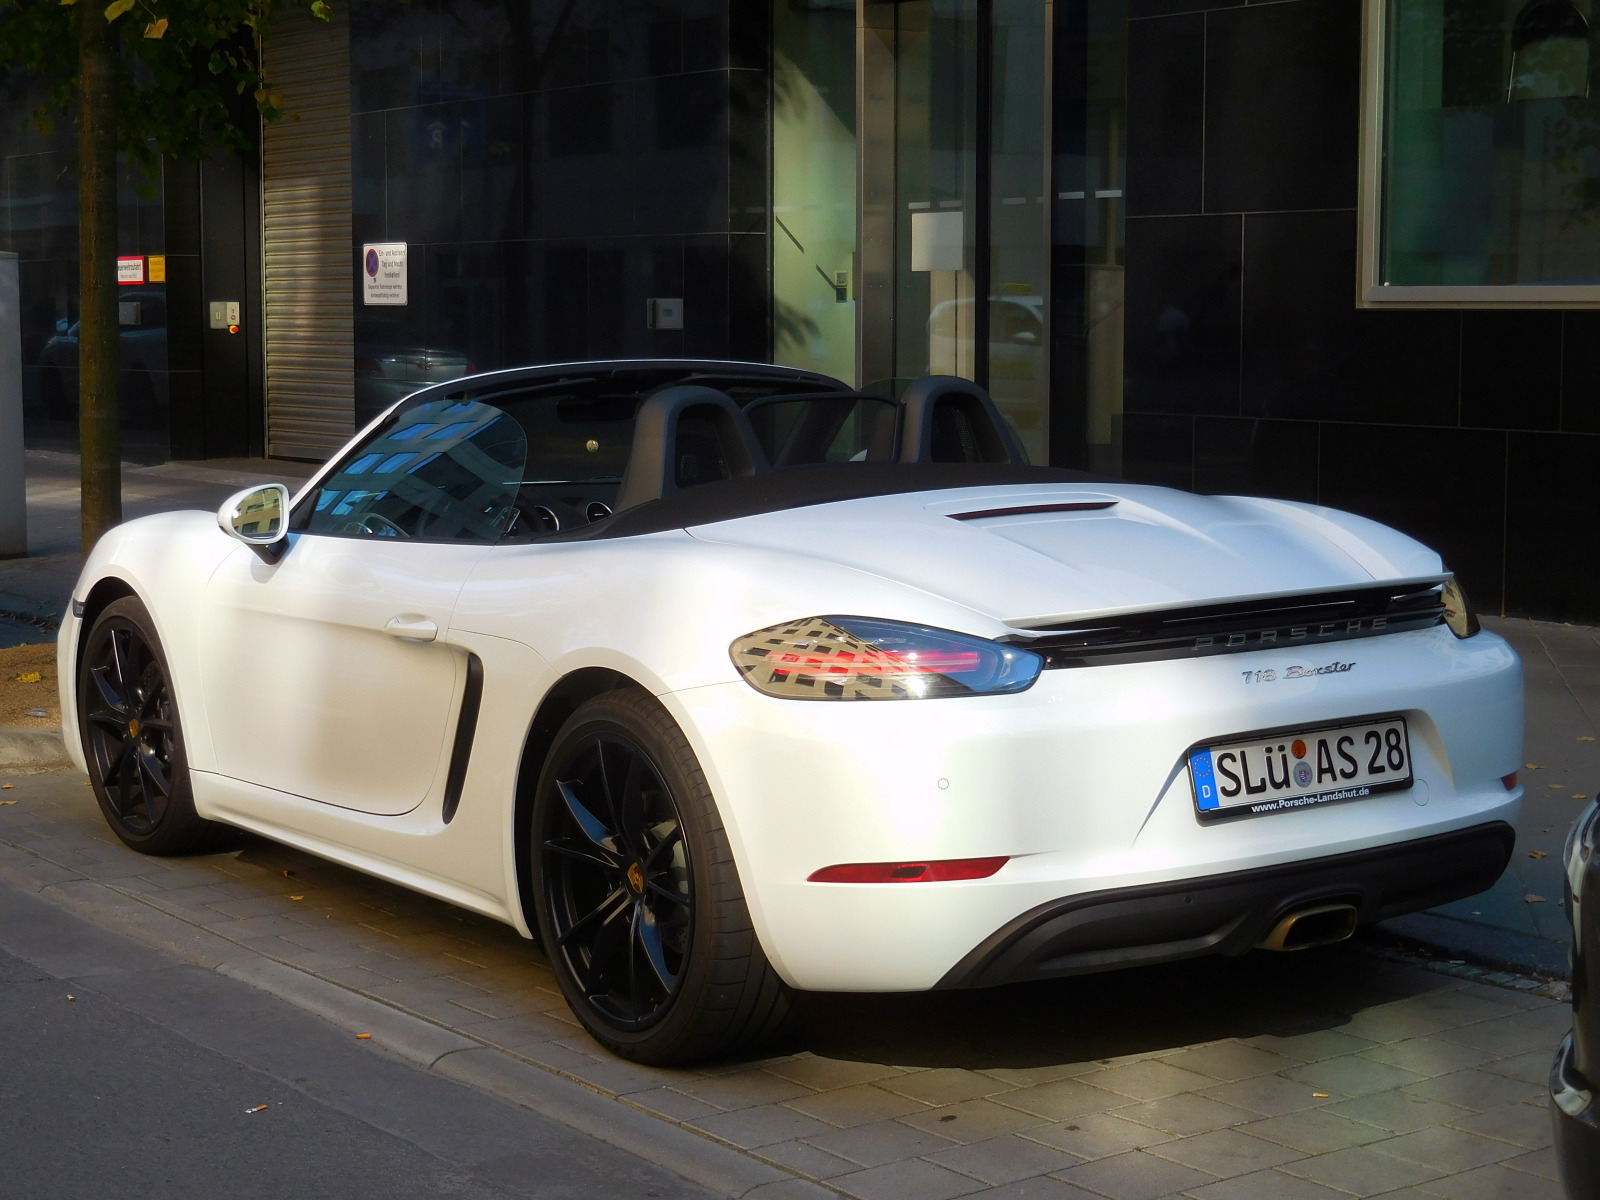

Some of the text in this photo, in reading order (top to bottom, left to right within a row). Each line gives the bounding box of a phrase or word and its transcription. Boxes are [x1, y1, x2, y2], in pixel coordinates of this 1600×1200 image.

[1193, 617, 1387, 650] PORSCHE
[1242, 661, 1356, 684] 718 Boxster
[1202, 784, 1211, 798] D
[1251, 787, 1370, 813] www.Porsche-Landshut.de
